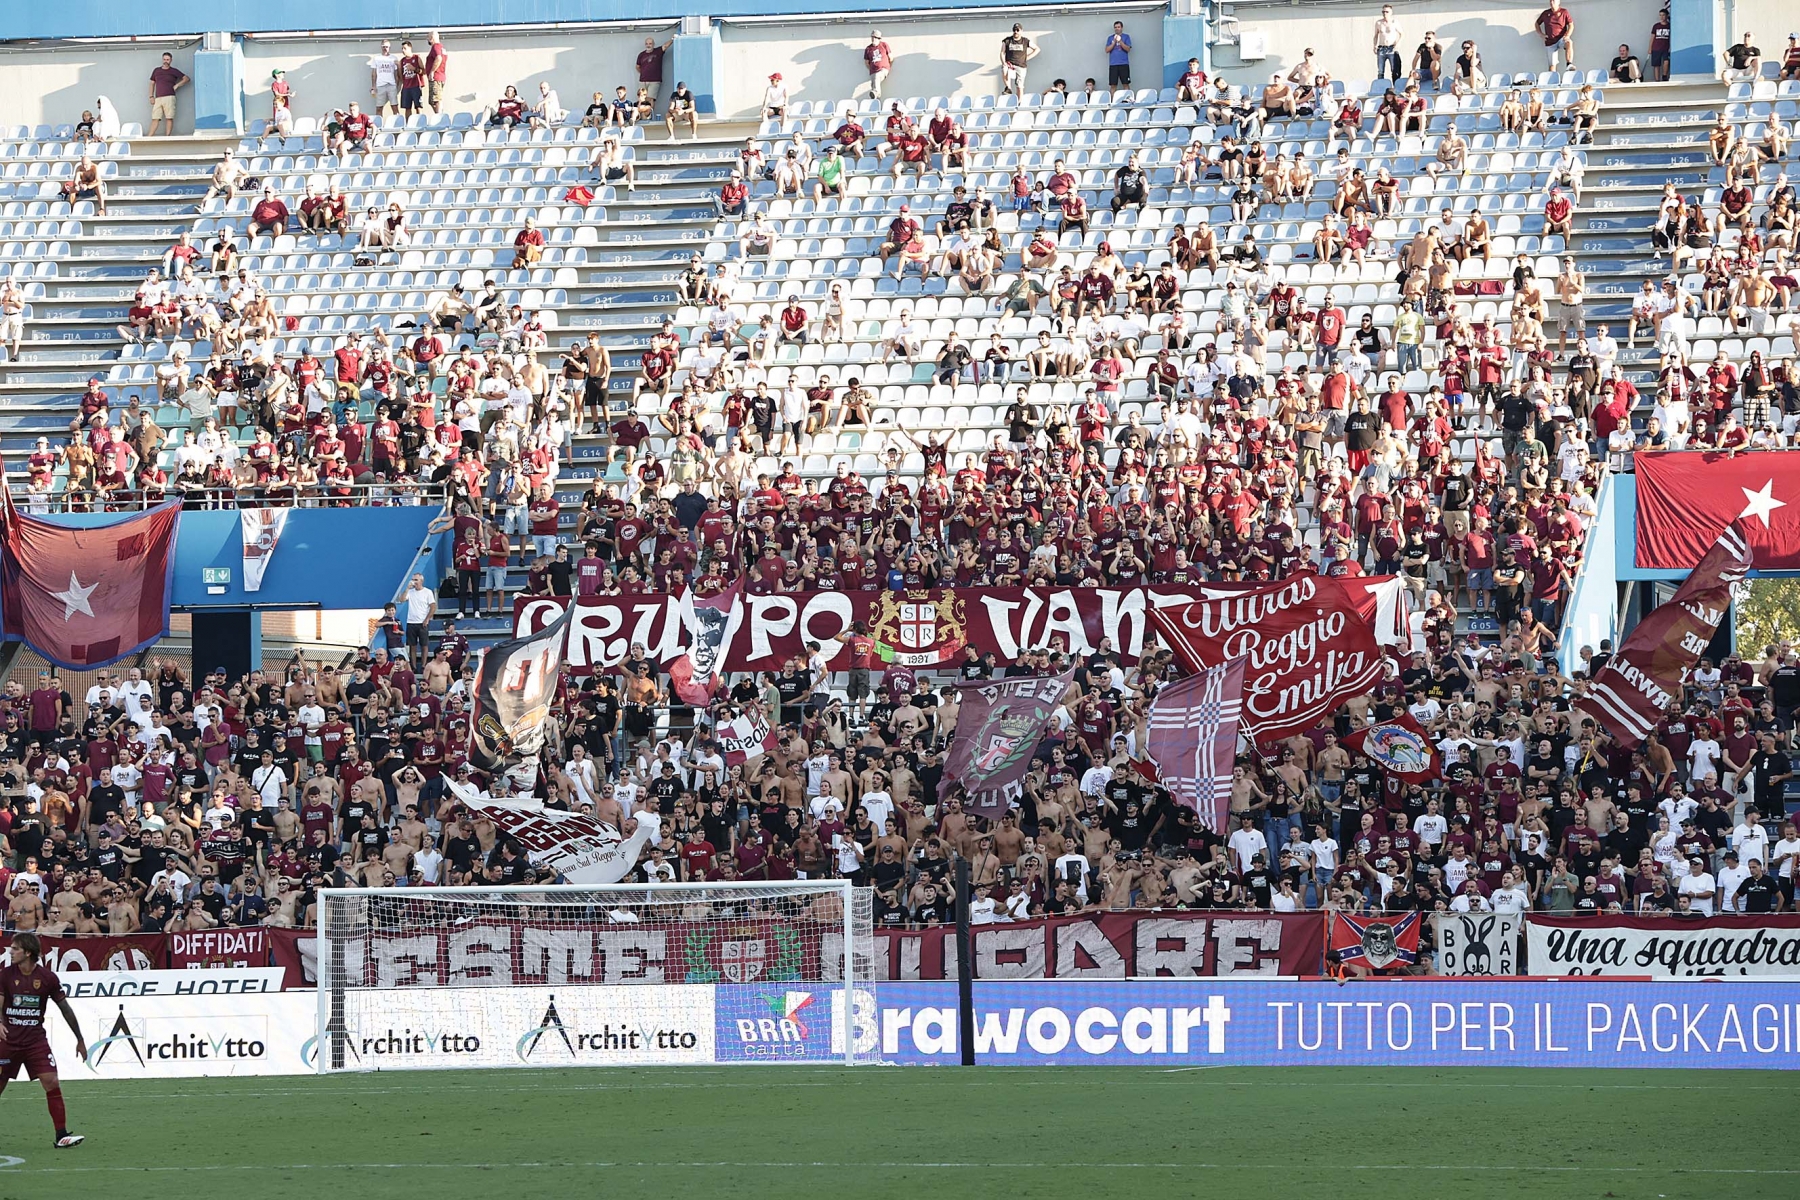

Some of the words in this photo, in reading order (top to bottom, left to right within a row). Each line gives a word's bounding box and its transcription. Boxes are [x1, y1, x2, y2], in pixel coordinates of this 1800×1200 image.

[1625, 117, 1636, 125] 28
[1648, 116, 1668, 124] FILA
[1689, 114, 1700, 122] 28
[1619, 138, 1631, 146] 27
[1683, 135, 1695, 143] 27
[726, 150, 736, 158] 28
[1615, 158, 1626, 166] 26
[1673, 177, 1684, 185] 25
[1595, 200, 1603, 208] G
[1589, 221, 1597, 229] G
[1598, 221, 1608, 229] 23
[1579, 264, 1587, 272] G
[1644, 263, 1651, 271] H
[643, 316, 650, 324] G
[634, 338, 641, 346] G
[1477, 599, 1483, 607] G
[904, 607, 914, 621] S
[921, 607, 932, 621] P
[504, 620, 510, 628] G
[1471, 622, 1477, 630] G
[1479, 622, 1491, 630] 05
[903, 629, 916, 647] Q
[922, 629, 933, 641] R
[1223, 609, 1345, 676] Reggio
[1244, 650, 1370, 718] Emilia
[577, 856, 591, 868] Sud
[173, 931, 263, 955] DIFFIDATI
[728, 943, 739, 958] S
[748, 943, 758, 957] P
[1547, 929, 1628, 967] Una
[1635, 929, 1800, 976] squadra
[728, 964, 740, 980] Q
[748, 964, 758, 979] R
[175, 978, 269, 994] HOTEL
[831, 989, 1231, 1054] Brawocart
[1267, 1002, 1413, 1051] TUTTO
[1431, 1002, 1515, 1051] PER
[1534, 1002, 1569, 1051] IL
[1587, 1003, 1800, 1053] PACKAGI
[736, 1019, 800, 1041] BRA
[744, 1043, 805, 1056] carta
